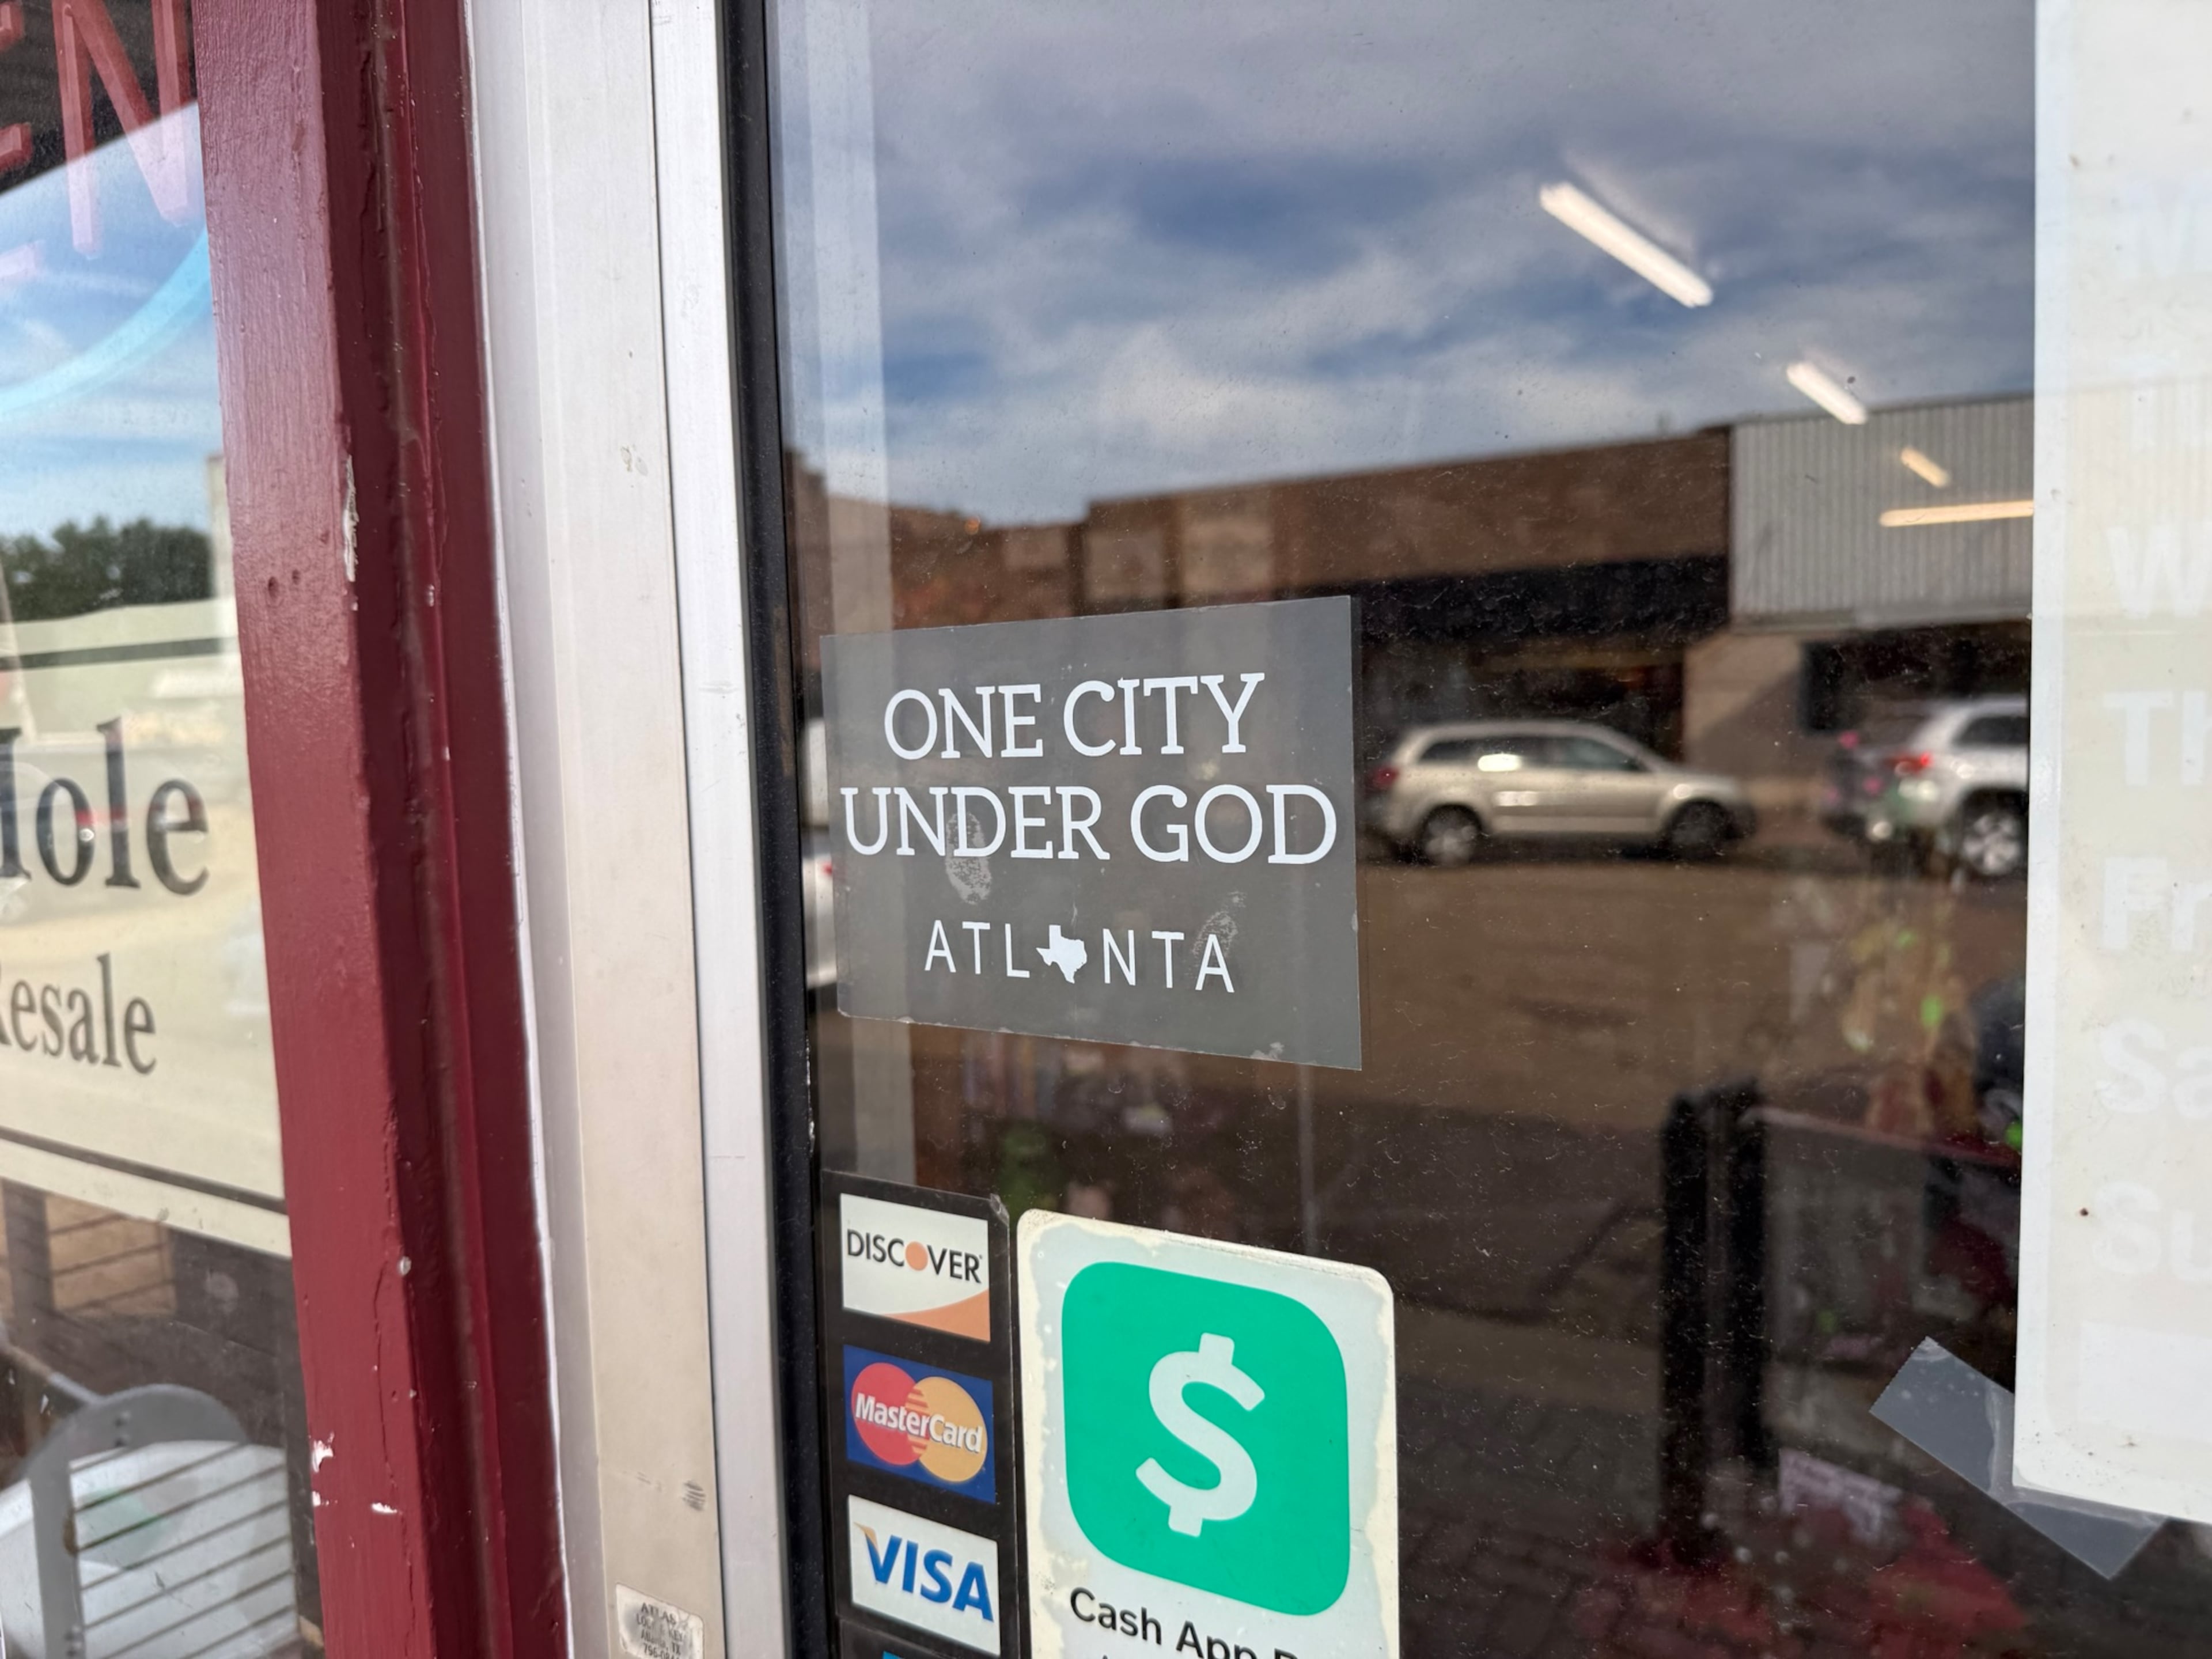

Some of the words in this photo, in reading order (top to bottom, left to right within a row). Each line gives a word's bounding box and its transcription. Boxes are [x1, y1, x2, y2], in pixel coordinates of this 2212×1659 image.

[884, 683, 1044, 760] ONE
[1063, 672, 1265, 757] CITY
[840, 786, 1110, 861] UNDER
[1130, 783, 1337, 865] GOD
[925, 919, 1235, 994] ATLNTA
[0, 952, 157, 1075] esale
[847, 1228, 983, 1285] DISCOVER
[855, 1392, 983, 1453] MasterCard
[853, 1521, 995, 1623] VISA
[1069, 1586, 1162, 1646] Cash
